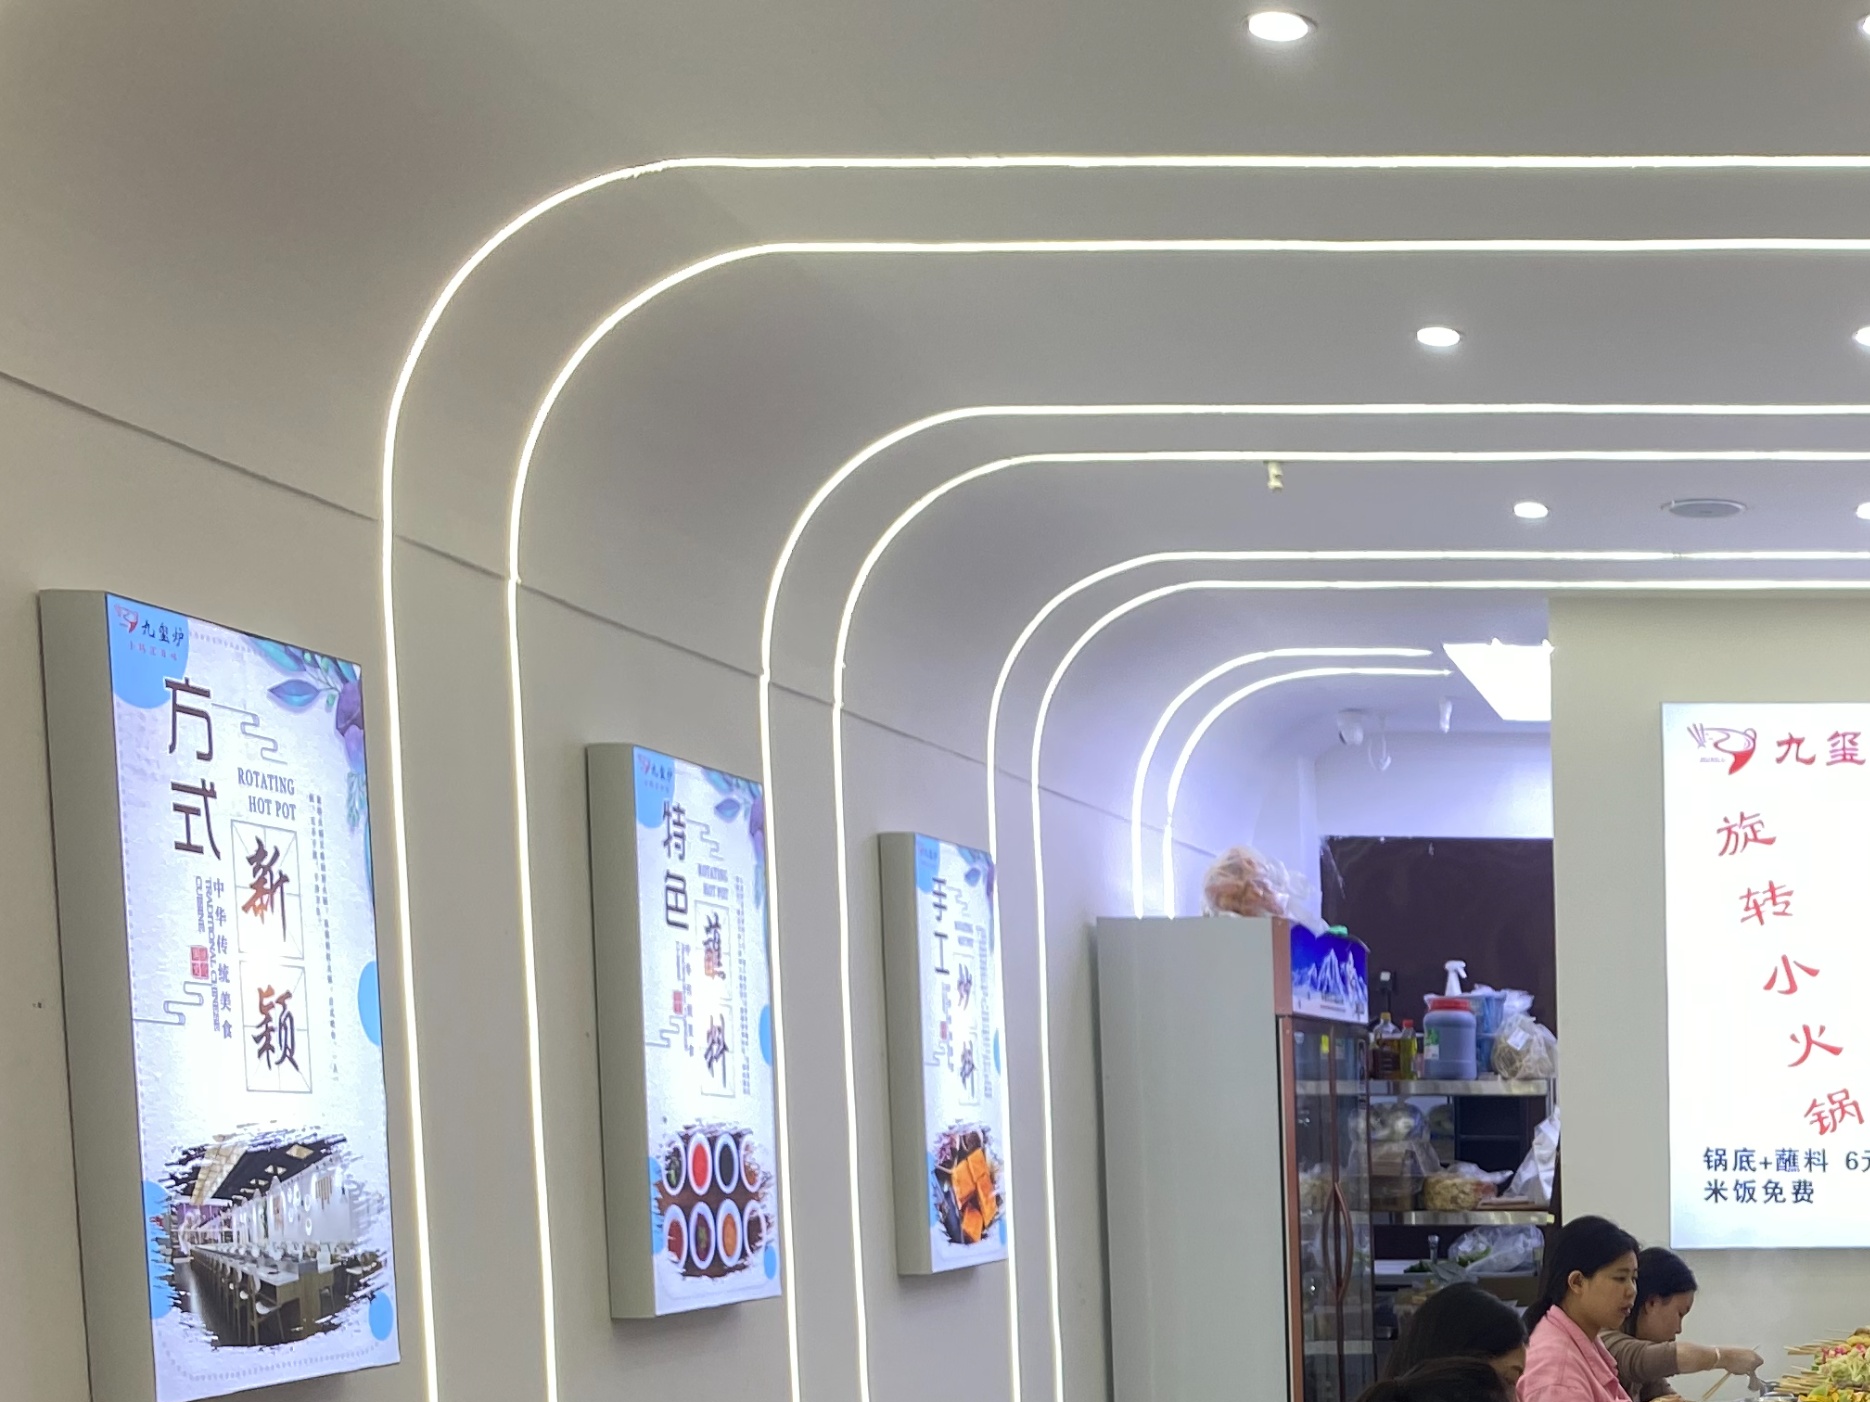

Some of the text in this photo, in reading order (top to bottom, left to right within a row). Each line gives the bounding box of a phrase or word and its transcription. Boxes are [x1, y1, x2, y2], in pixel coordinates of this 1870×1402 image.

[165, 677, 221, 860] 方式
[237, 766, 295, 796] ROTATING
[248, 795, 296, 820] HOT POT
[213, 878, 233, 1039] 中华传统美食
[241, 835, 300, 1071] 新颖
[1716, 811, 1865, 1136] 旋转小火锅
[1703, 1146, 1829, 1173] 锅底+蘸料
[1703, 1179, 1815, 1204] 米饭免费
